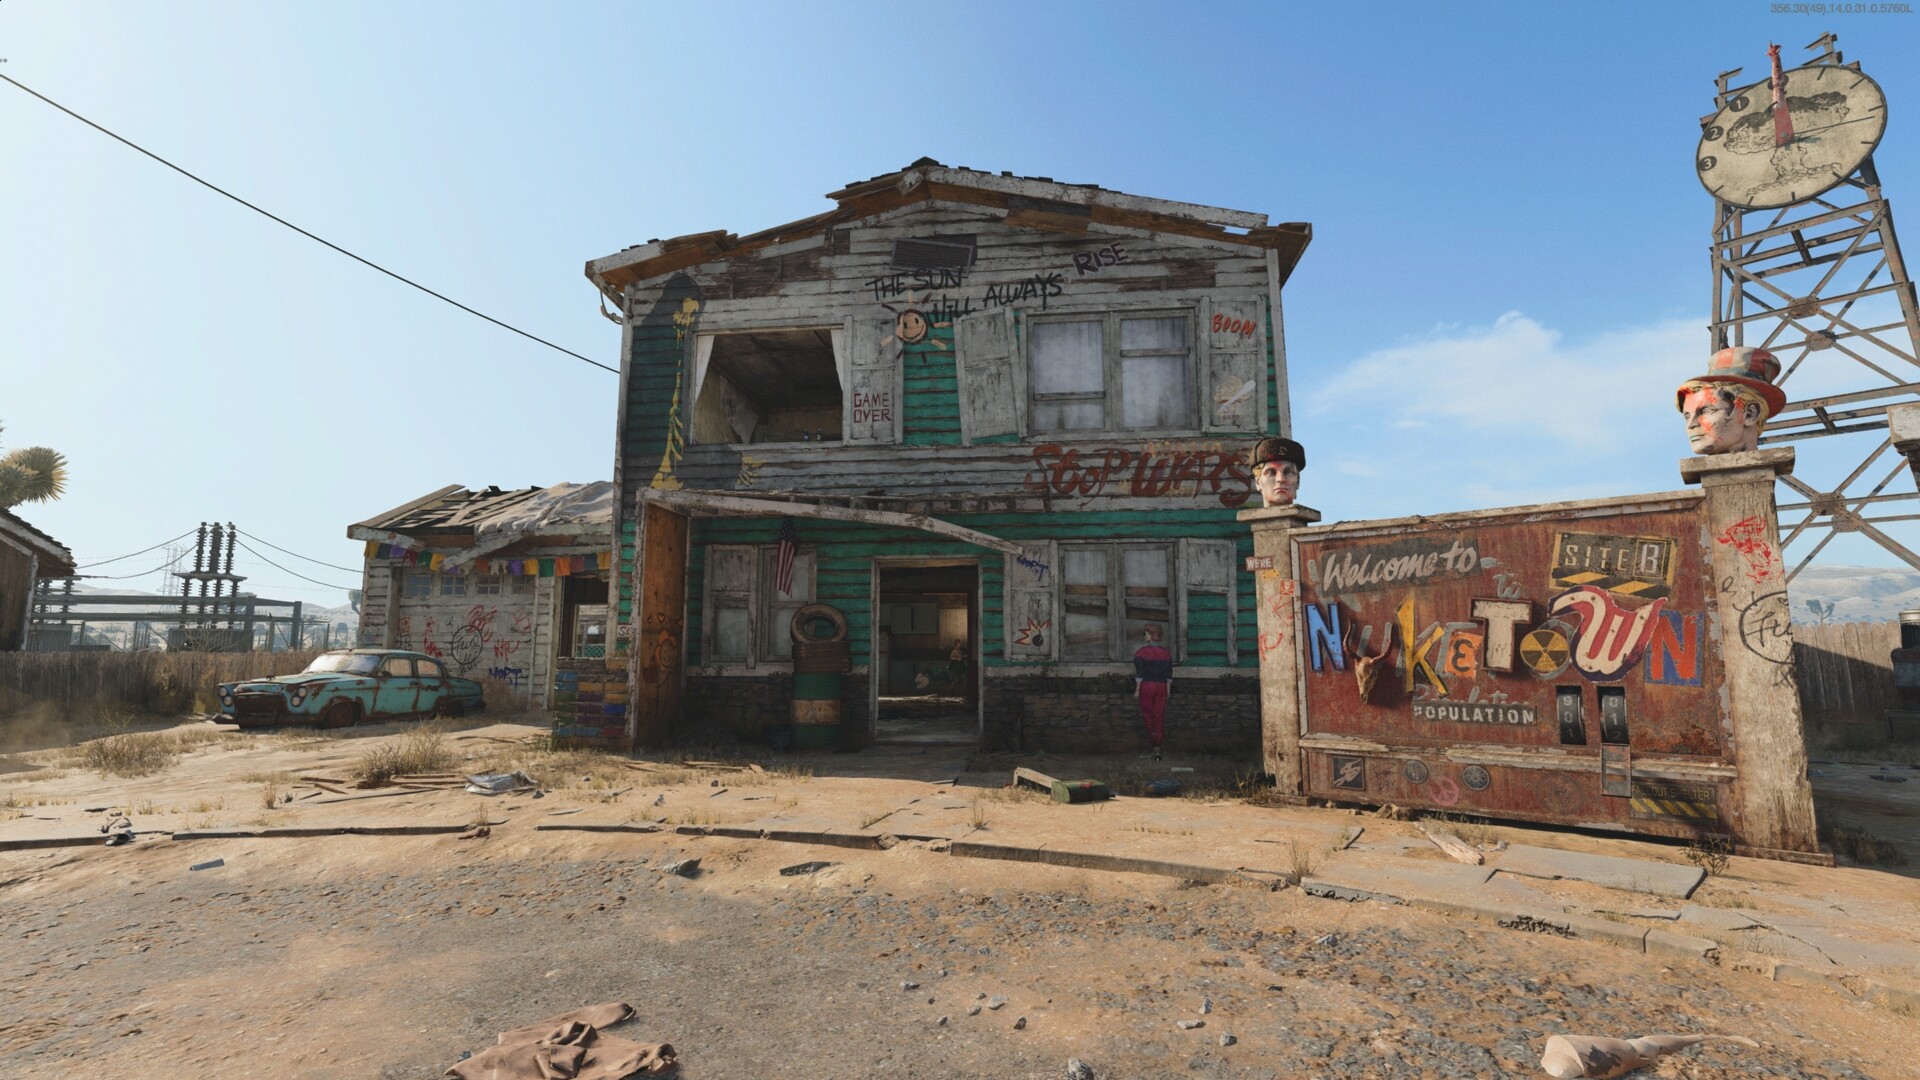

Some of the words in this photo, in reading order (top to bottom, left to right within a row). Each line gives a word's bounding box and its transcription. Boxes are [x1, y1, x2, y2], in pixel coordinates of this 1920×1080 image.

[1072, 241, 1129, 276] RISE
[865, 272, 908, 300] THE
[911, 266, 964, 292] SUN
[922, 294, 976, 328] WILL
[982, 272, 1063, 310] ALWAYS
[1212, 312, 1258, 339] BOOM
[853, 392, 889, 408] GAME
[853, 408, 892, 423] OVER
[1323, 552, 1439, 591] Welcome
[1439, 541, 1477, 573] to
[1564, 544, 1630, 571] SITE
[1640, 544, 1660, 574] B
[1413, 704, 1535, 724] POPULATION
[1631, 785, 1668, 798] FALLOUT
[1670, 786, 1710, 801] SHELTER
